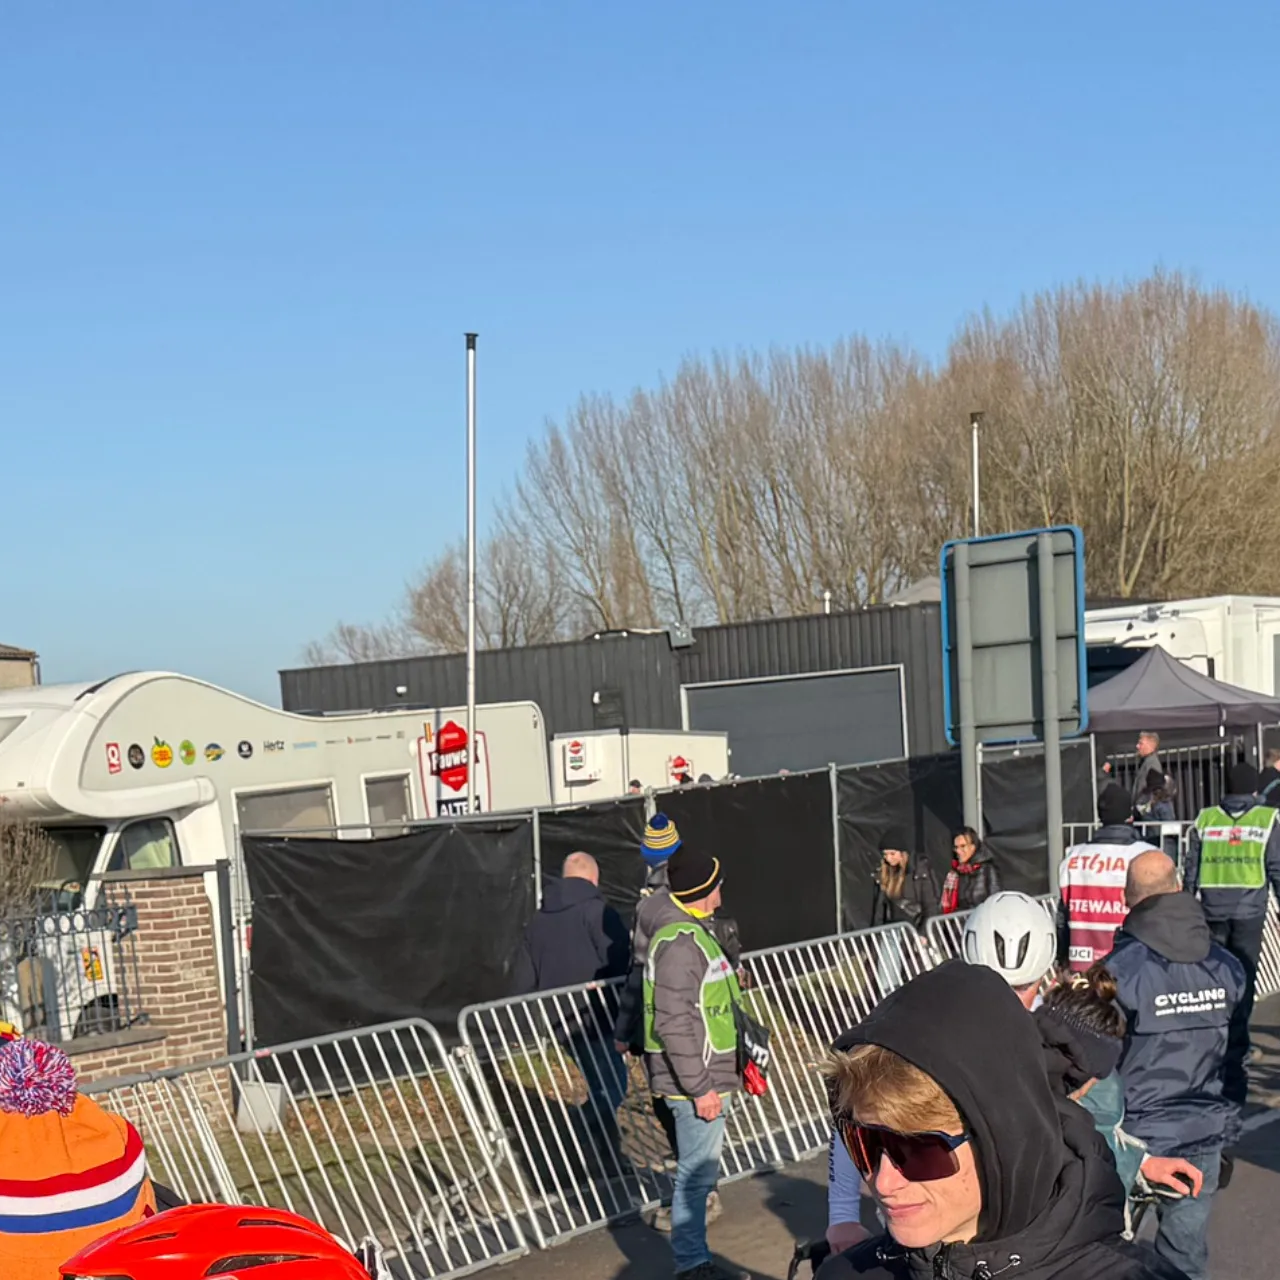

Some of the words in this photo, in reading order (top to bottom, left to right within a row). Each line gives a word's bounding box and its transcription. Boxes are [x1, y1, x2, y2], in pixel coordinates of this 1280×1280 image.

[263, 739, 285, 752] Hertz
[431, 747, 470, 772] Pauwe
[1154, 987, 1226, 1007] CYCLING
